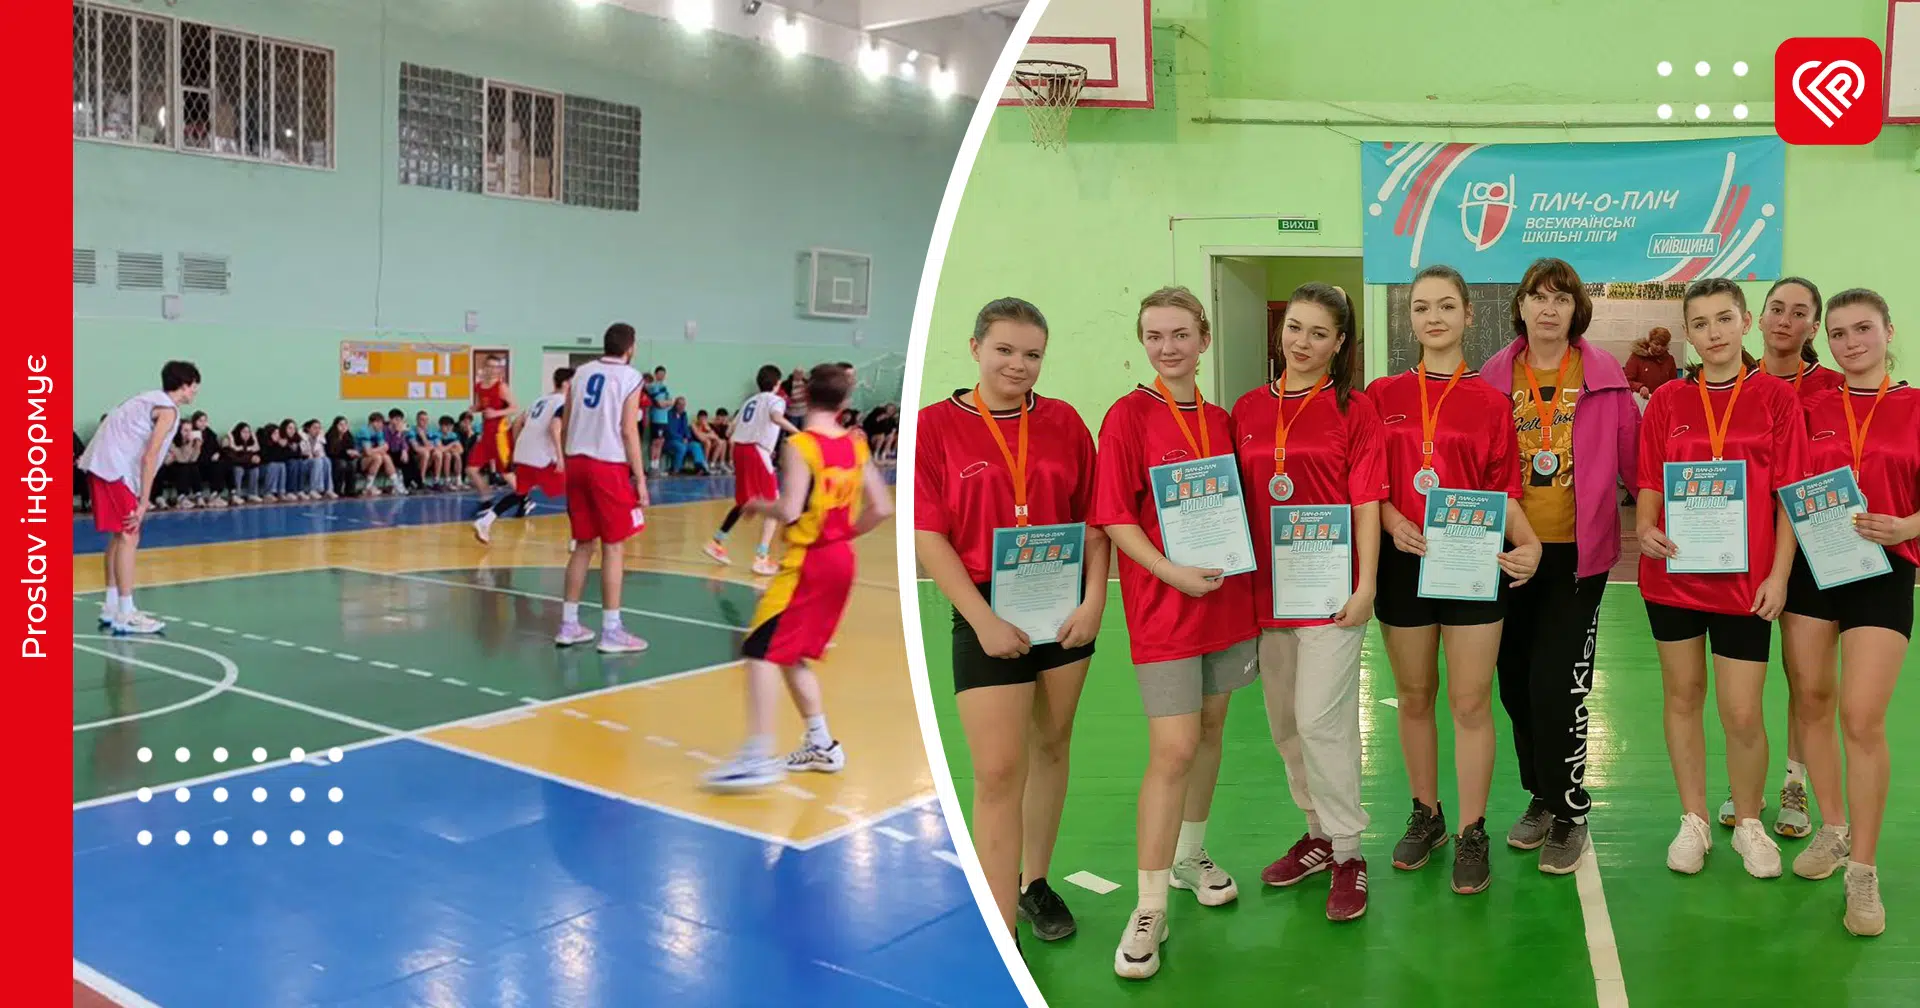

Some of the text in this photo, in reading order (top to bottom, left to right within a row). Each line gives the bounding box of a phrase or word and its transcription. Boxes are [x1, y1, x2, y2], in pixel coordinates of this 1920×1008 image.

[1529, 189, 1680, 212] ПЛІЧ-О-ПЛІЧ
[1282, 220, 1315, 230] ВИХІД
[1525, 215, 1637, 229] ВСЕУКРАЇНСЬКІ
[1521, 230, 1618, 243] ШКІЛЬНІ ЛІГИ
[1652, 237, 1715, 255] КИЇВЩИНА
[583, 373, 606, 408] 9
[742, 400, 757, 422] 6
[1180, 493, 1224, 515] ДИПЛОМ
[1443, 524, 1487, 539] ДИПЛОМ
[1564, 703, 1592, 811] Calvin
